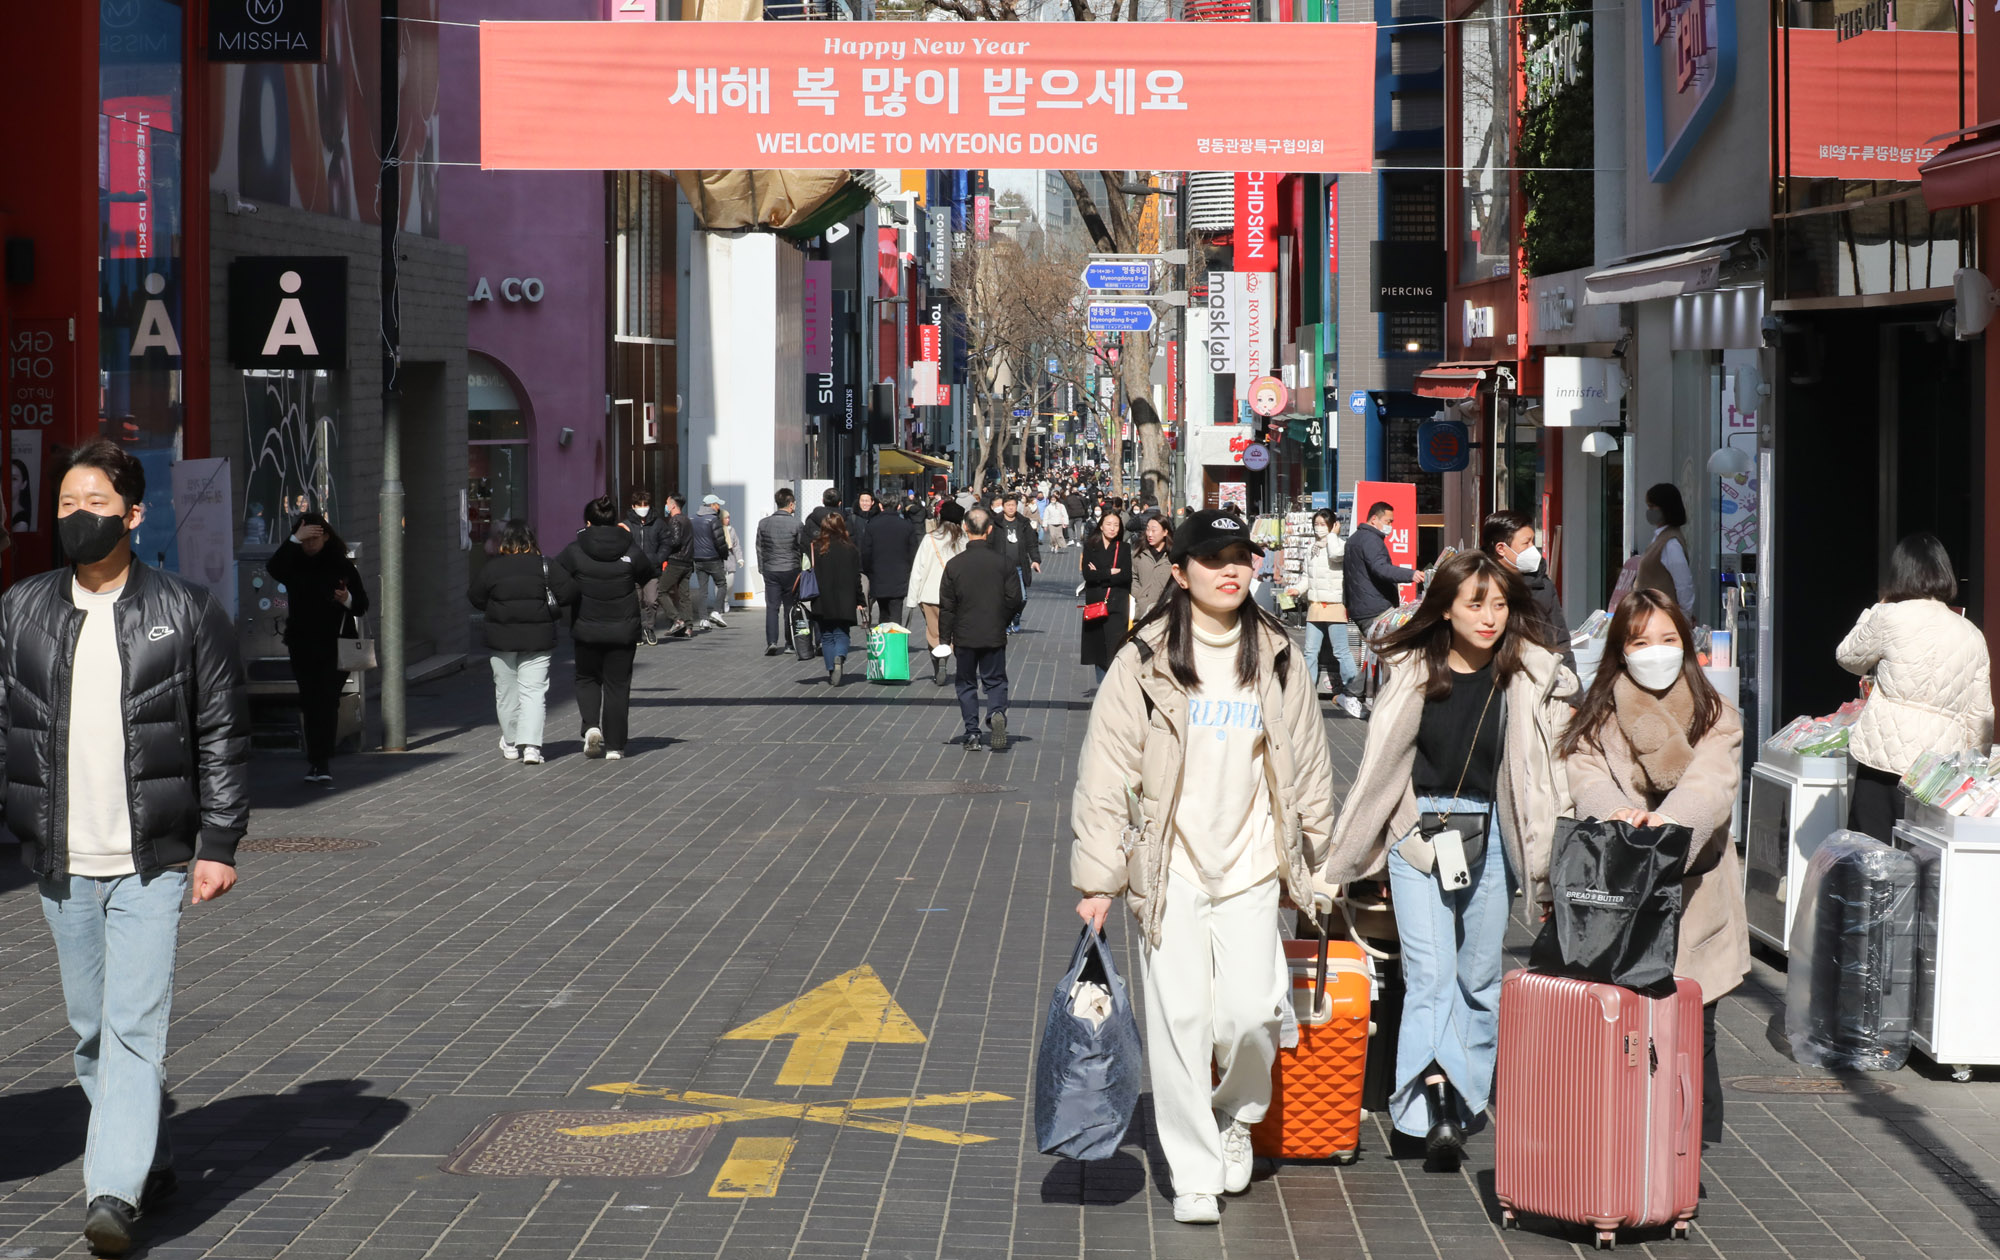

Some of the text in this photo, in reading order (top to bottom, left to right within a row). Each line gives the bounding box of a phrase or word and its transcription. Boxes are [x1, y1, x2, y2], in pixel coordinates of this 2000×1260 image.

[219, 32, 308, 50] MISSHA
[825, 37, 1030, 60] Happy New Year
[668, 67, 1188, 118] 새해 복 많이 받으세요
[756, 132, 1098, 155] WELCOME TO MYEONG DONG
[1196, 138, 1324, 155] 명동관광특구협의회
[936, 213, 944, 275] CONVERSE
[1122, 266, 1148, 275] 명동8길
[468, 277, 545, 302] A CO
[1381, 287, 1433, 296] PIERCING
[1091, 307, 1116, 316] 명동8길
[1209, 272, 1230, 372] masklab
[1248, 299, 1259, 348] ROYAL
[845, 388, 853, 430] SKINFOOD
[1353, 398, 1367, 407] ADT
[1565, 891, 1591, 899] BREAD
[1597, 894, 1625, 903] BUTTER
